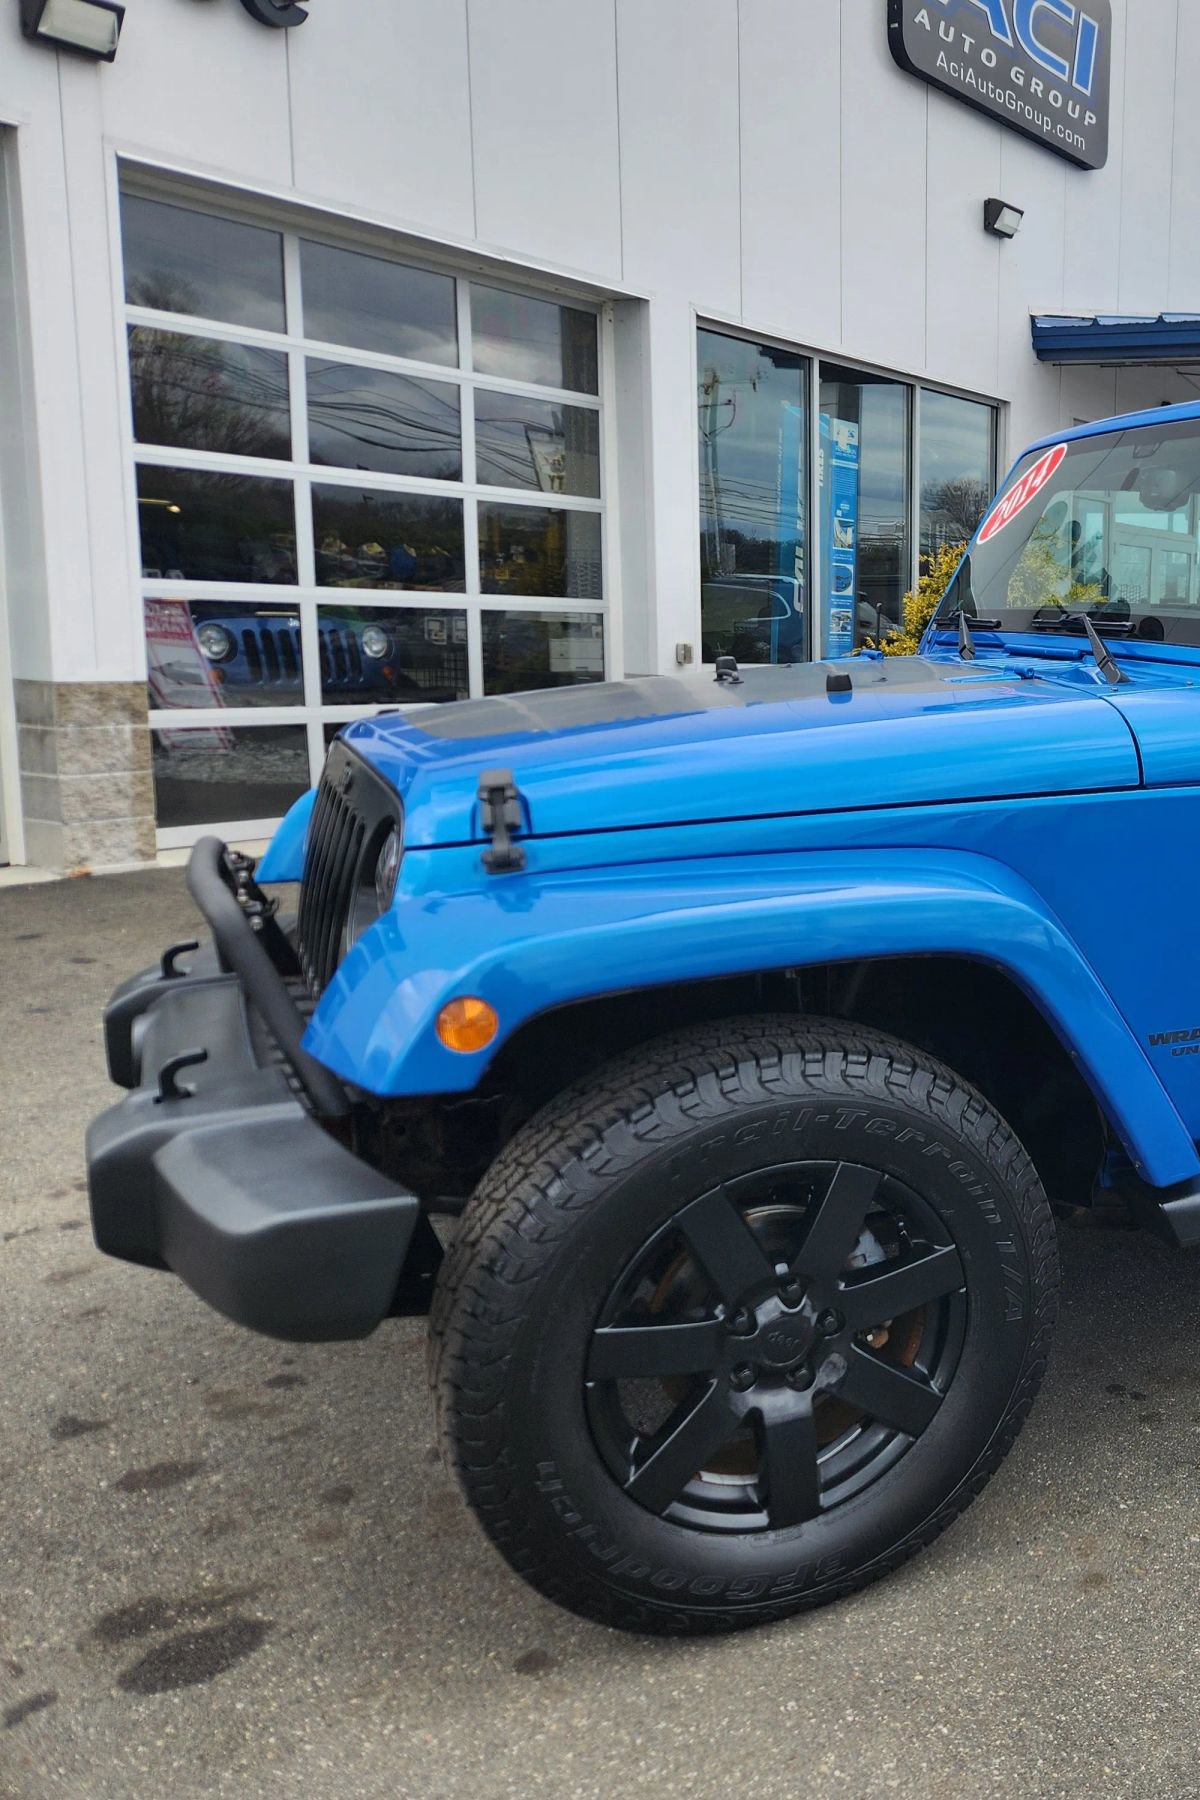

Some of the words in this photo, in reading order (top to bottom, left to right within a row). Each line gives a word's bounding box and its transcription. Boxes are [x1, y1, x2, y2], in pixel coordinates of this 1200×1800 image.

[914, 8, 997, 69] AUTO
[1010, 65, 1097, 127] GROUP
[936, 51, 1086, 151] AciAutoGroup.com
[987, 452, 1055, 538] 2014
